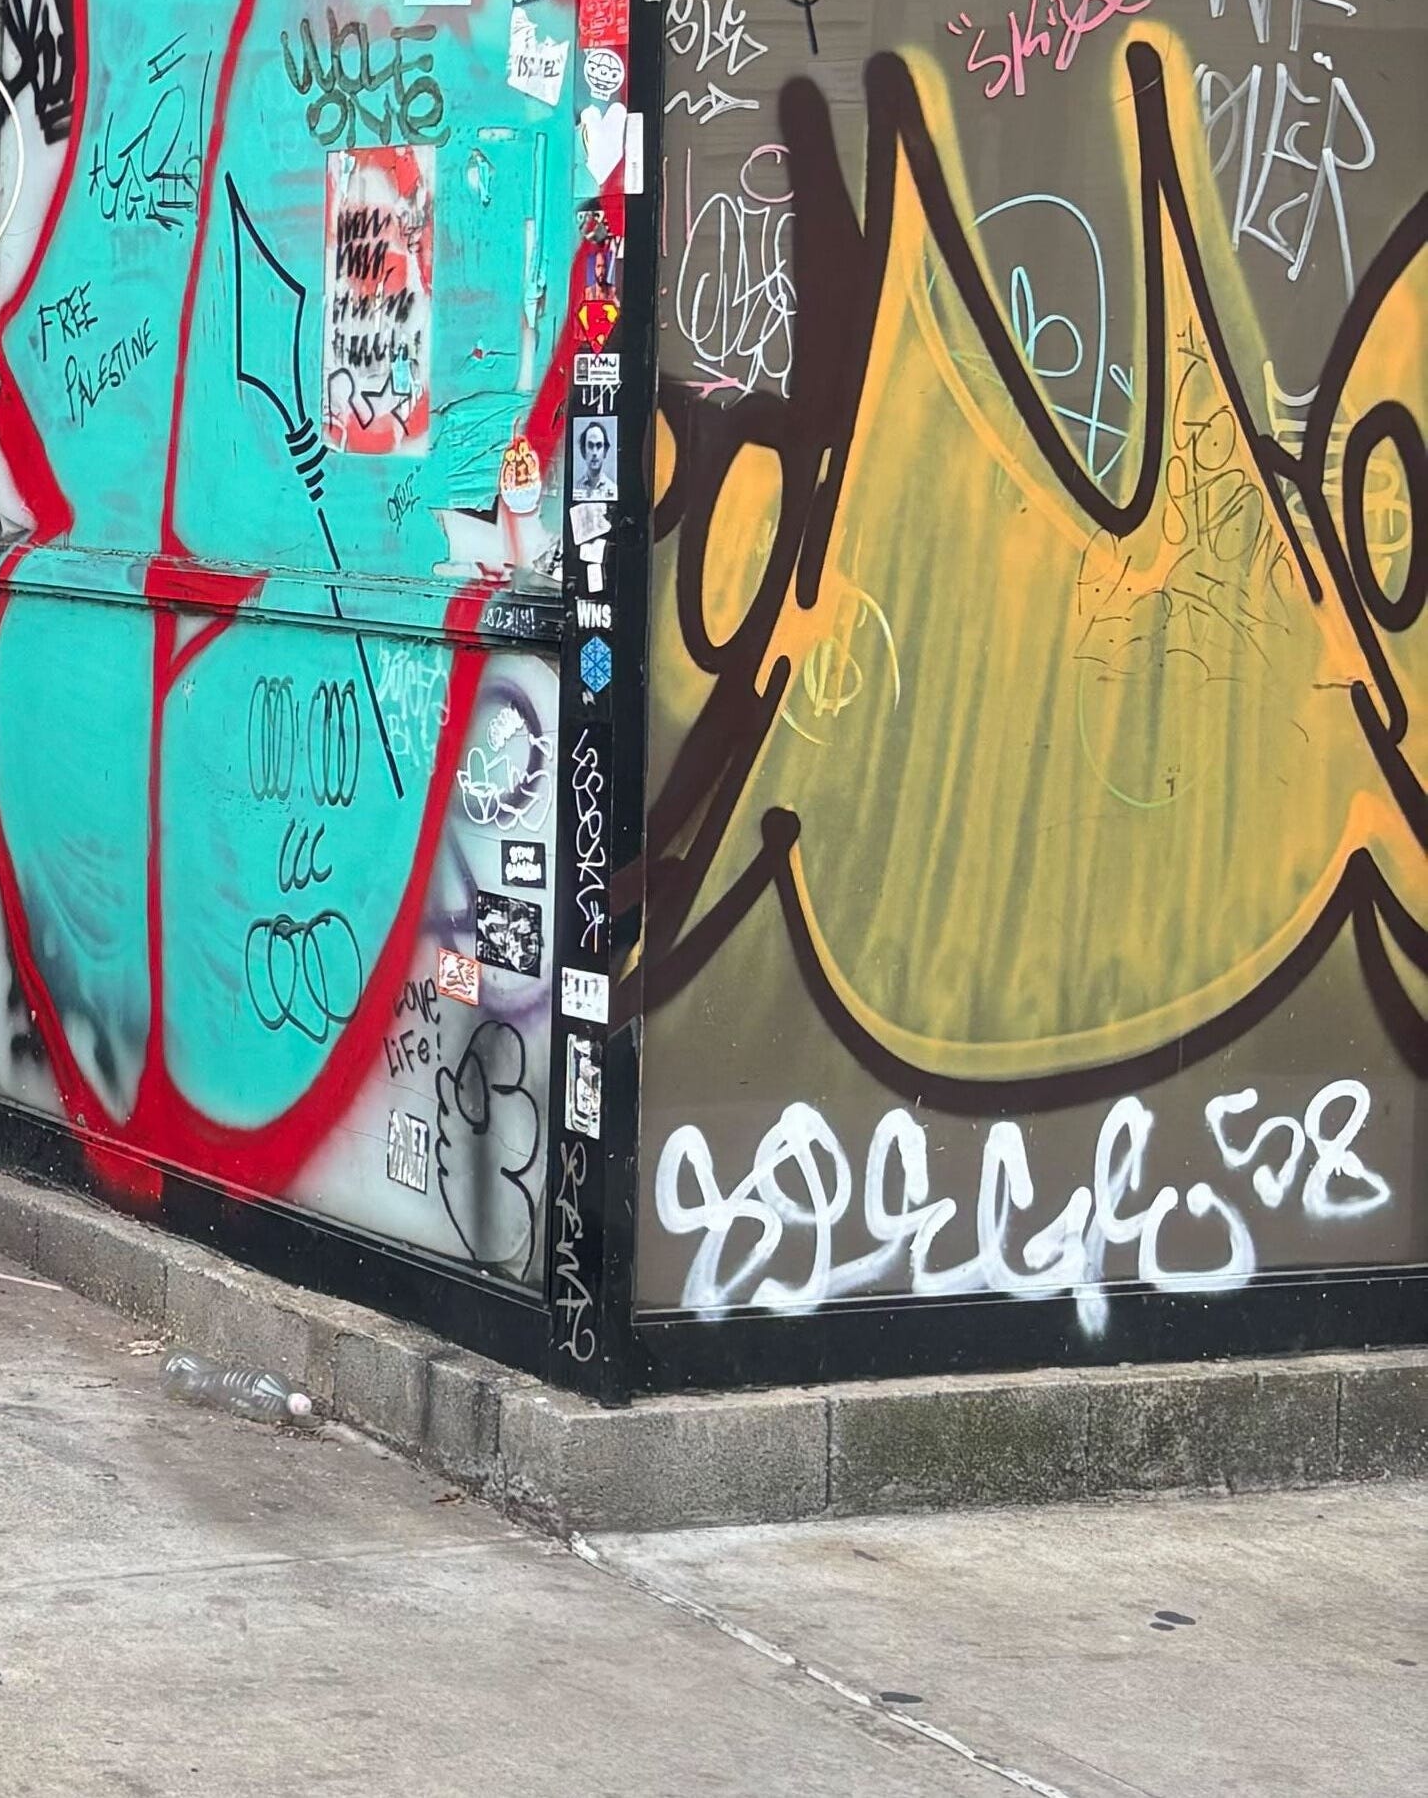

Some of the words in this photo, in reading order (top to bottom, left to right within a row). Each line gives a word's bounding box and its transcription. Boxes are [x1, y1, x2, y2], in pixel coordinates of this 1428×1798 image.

[36, 280, 99, 363] FREE
[64, 316, 159, 429] PALESTINE
[589, 355, 617, 368] KMJ
[575, 599, 613, 630] WNS
